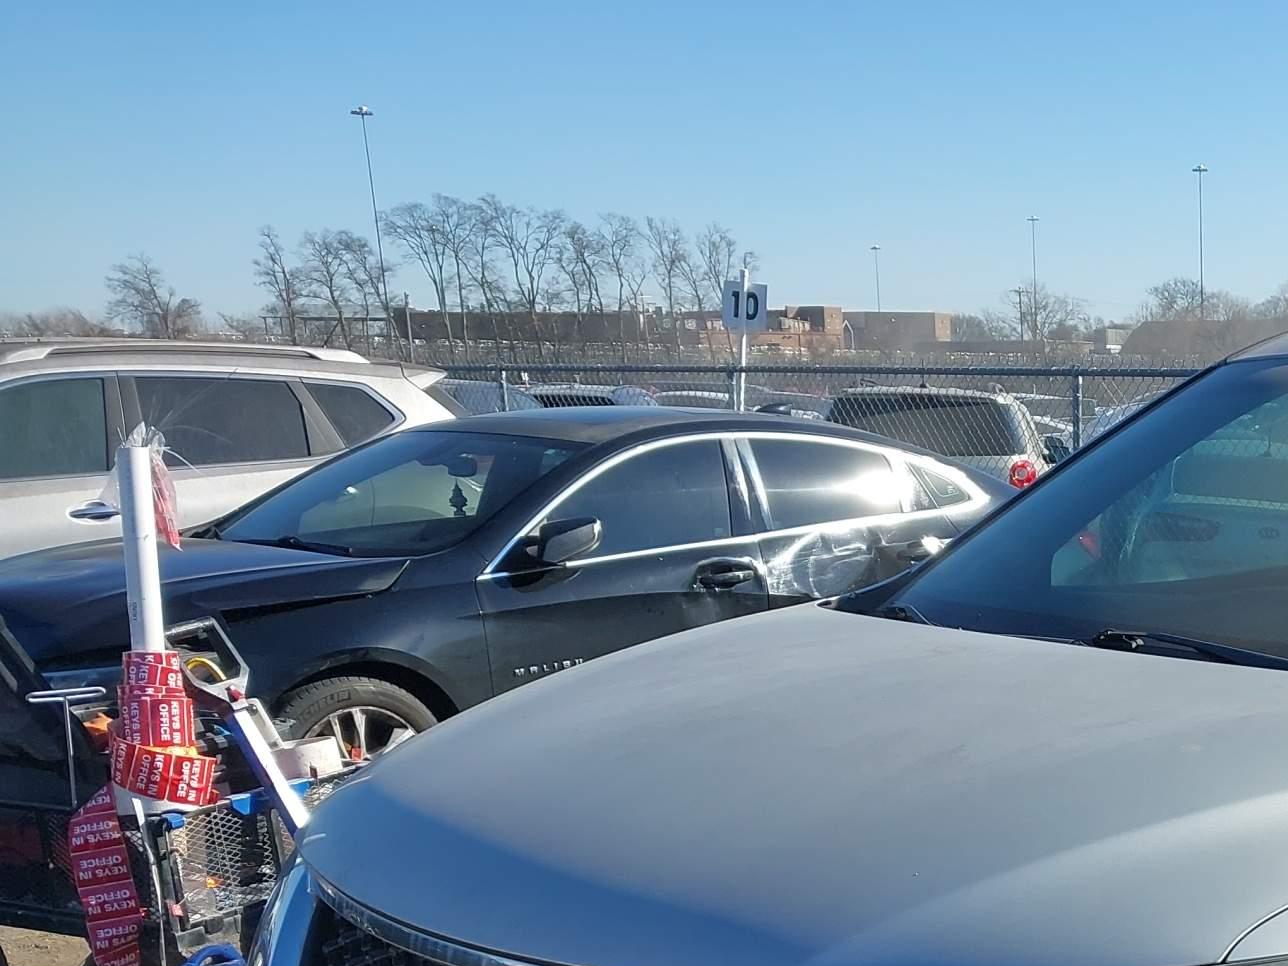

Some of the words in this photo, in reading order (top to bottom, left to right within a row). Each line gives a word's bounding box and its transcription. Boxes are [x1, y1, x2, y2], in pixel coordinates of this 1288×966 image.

[171, 701, 180, 729] KEYS
[159, 703, 170, 741] OFFICE
[173, 732, 181, 744] IN
[136, 755, 151, 790] OFFICE
[151, 754, 164, 781] KEYS
[190, 759, 201, 788] KEYS
[187, 789, 196, 801] IN
[74, 821, 112, 834] OFFICE
[72, 837, 84, 847] IN
[87, 831, 120, 844] KEYS
[80, 856, 122, 869] OFFICE
[79, 871, 91, 880] IN
[96, 865, 127, 878] KEYS
[88, 890, 130, 904] OFFICE
[88, 907, 101, 916] IN
[105, 899, 136, 912] KEYS
[96, 925, 138, 938] OFFICE
[96, 940, 108, 949] IN
